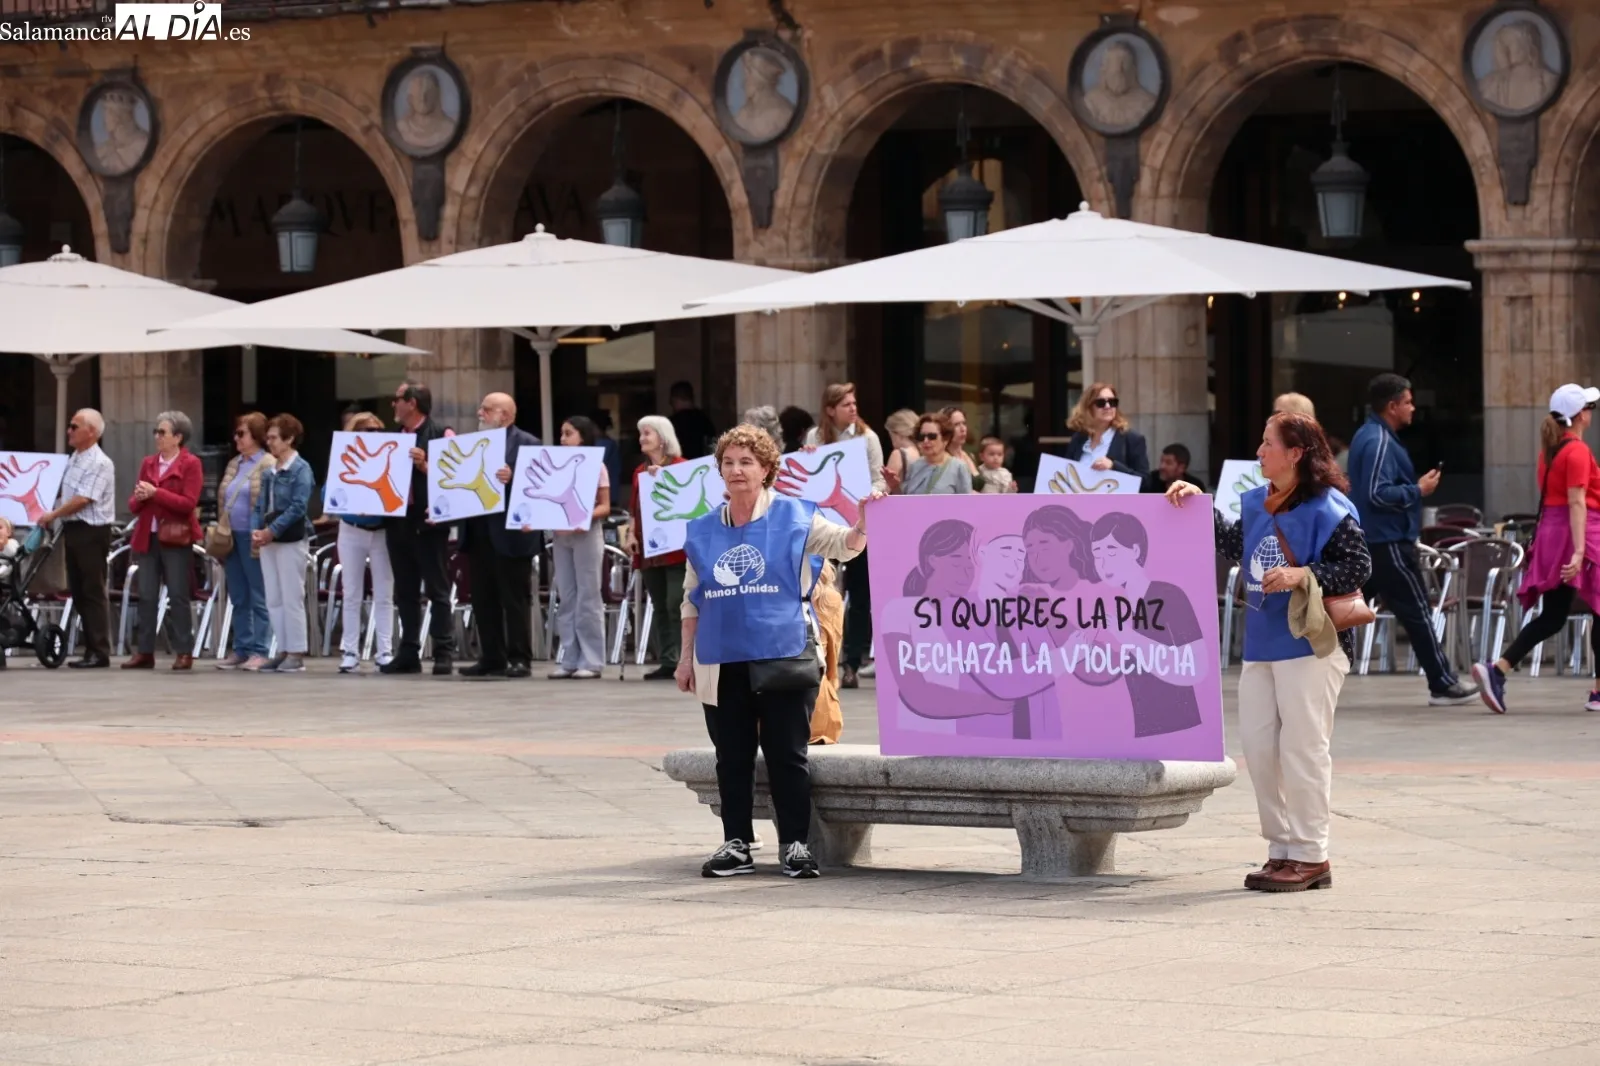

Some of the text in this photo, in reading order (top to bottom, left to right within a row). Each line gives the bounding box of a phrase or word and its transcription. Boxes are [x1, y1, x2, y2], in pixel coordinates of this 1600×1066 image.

[739, 583, 779, 594] Unidas
[914, 596, 1166, 632] SI QUIERES LA PAZ
[898, 640, 1197, 677] RECHAZA LA VIOLENCIA
